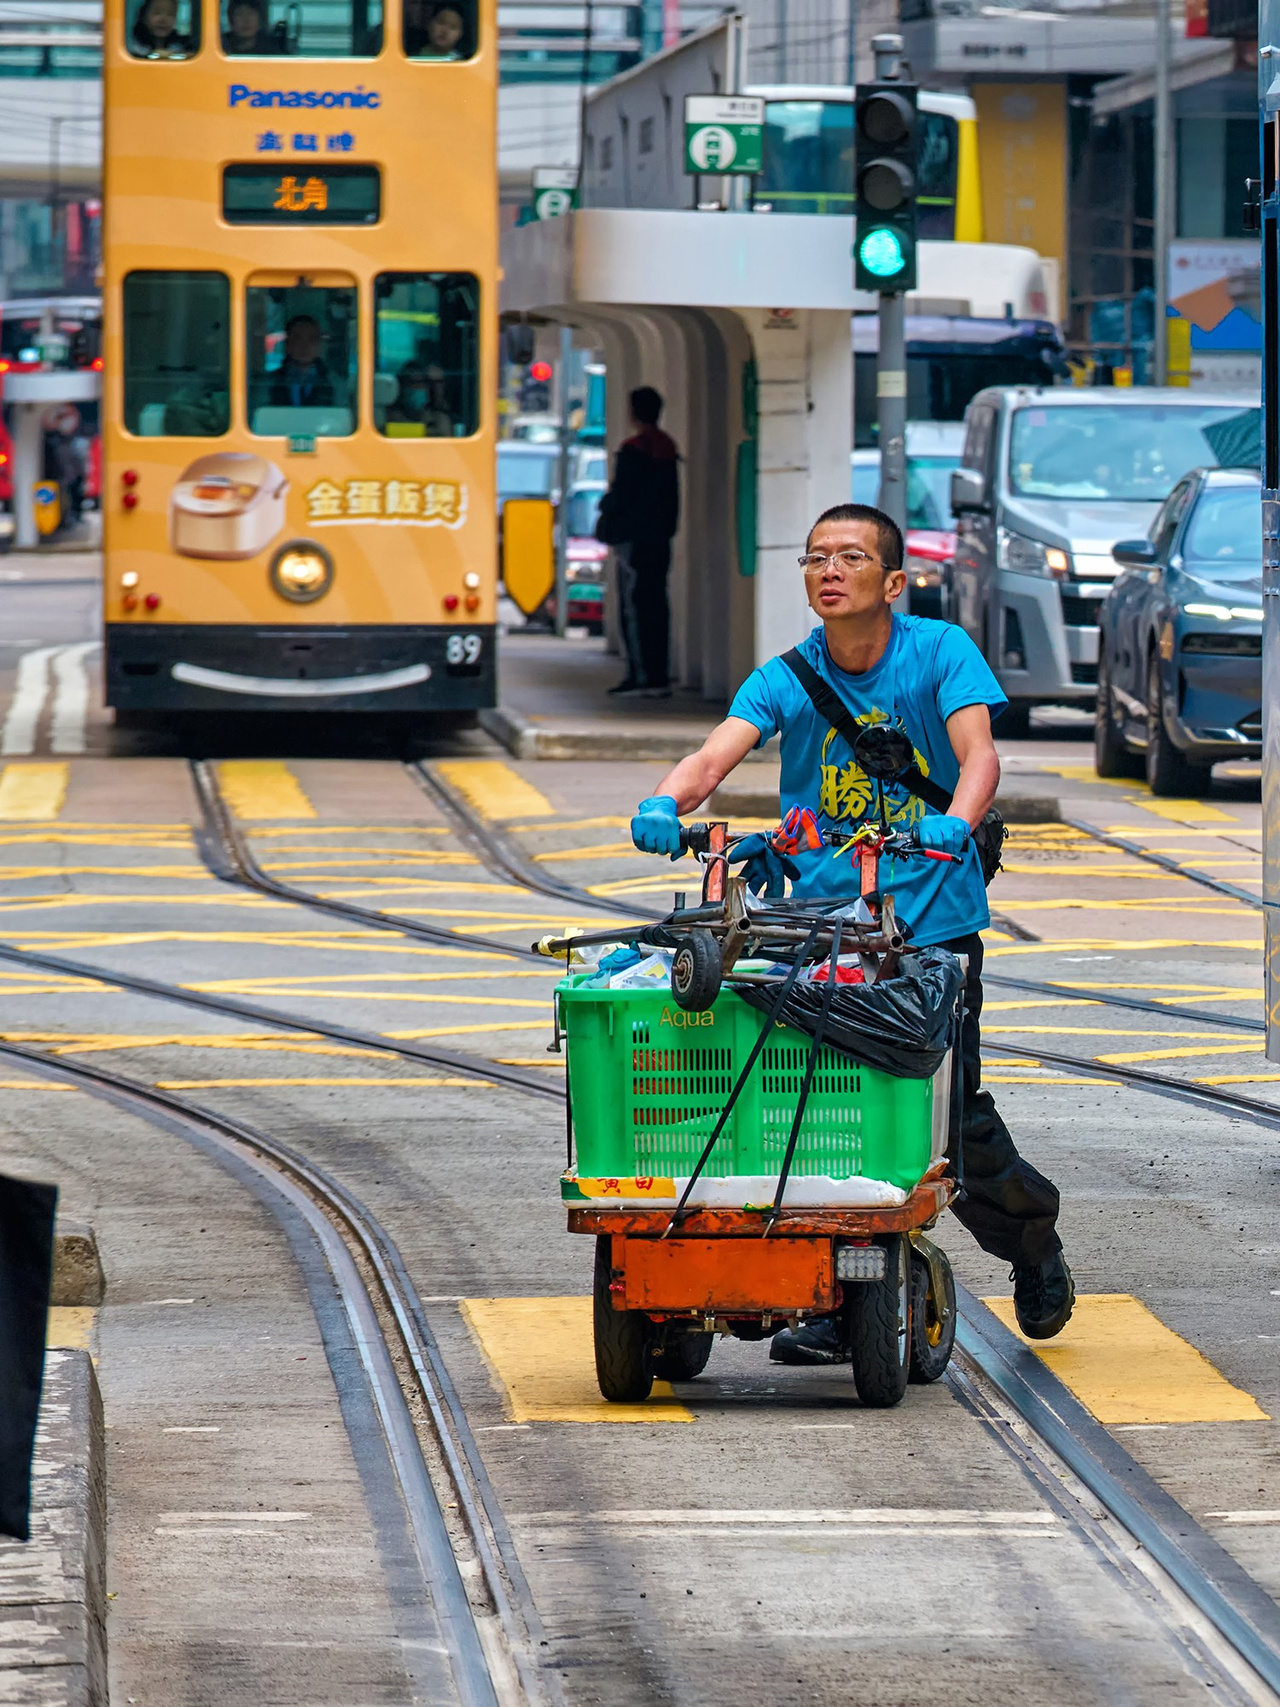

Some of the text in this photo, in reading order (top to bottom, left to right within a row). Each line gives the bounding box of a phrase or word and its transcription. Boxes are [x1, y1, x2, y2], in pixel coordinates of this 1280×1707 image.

[229, 84, 380, 109] Panasonic
[273, 175, 328, 211] 北角
[306, 478, 457, 518] 金蛋飯煲
[445, 634, 482, 664] 89
[659, 1006, 715, 1031] Aqua
